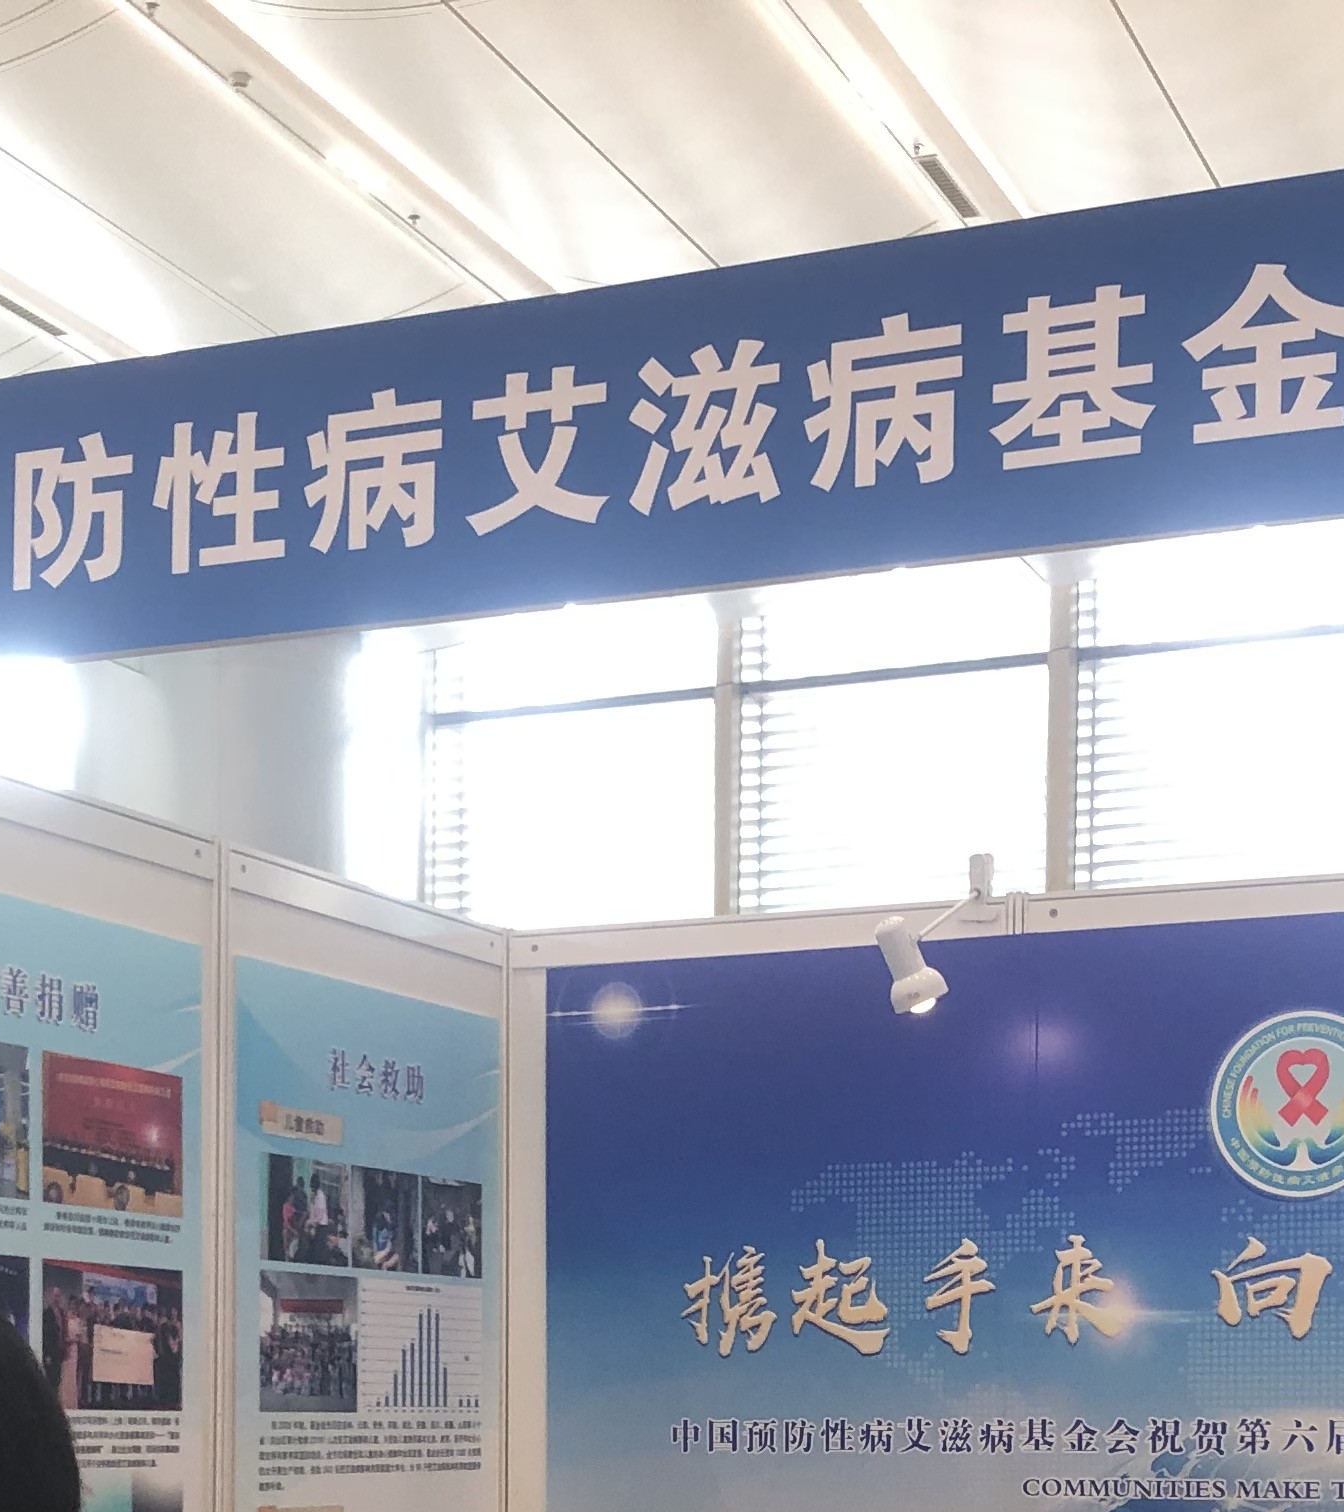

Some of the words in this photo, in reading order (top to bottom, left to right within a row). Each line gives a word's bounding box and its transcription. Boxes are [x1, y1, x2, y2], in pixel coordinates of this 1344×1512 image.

[329, 1048, 425, 1103] 社会救助
[682, 1234, 1126, 1357] 携起手来
[1022, 1477, 1226, 1500] COMMUNITIES
[1236, 1479, 1321, 1500] MAKE
